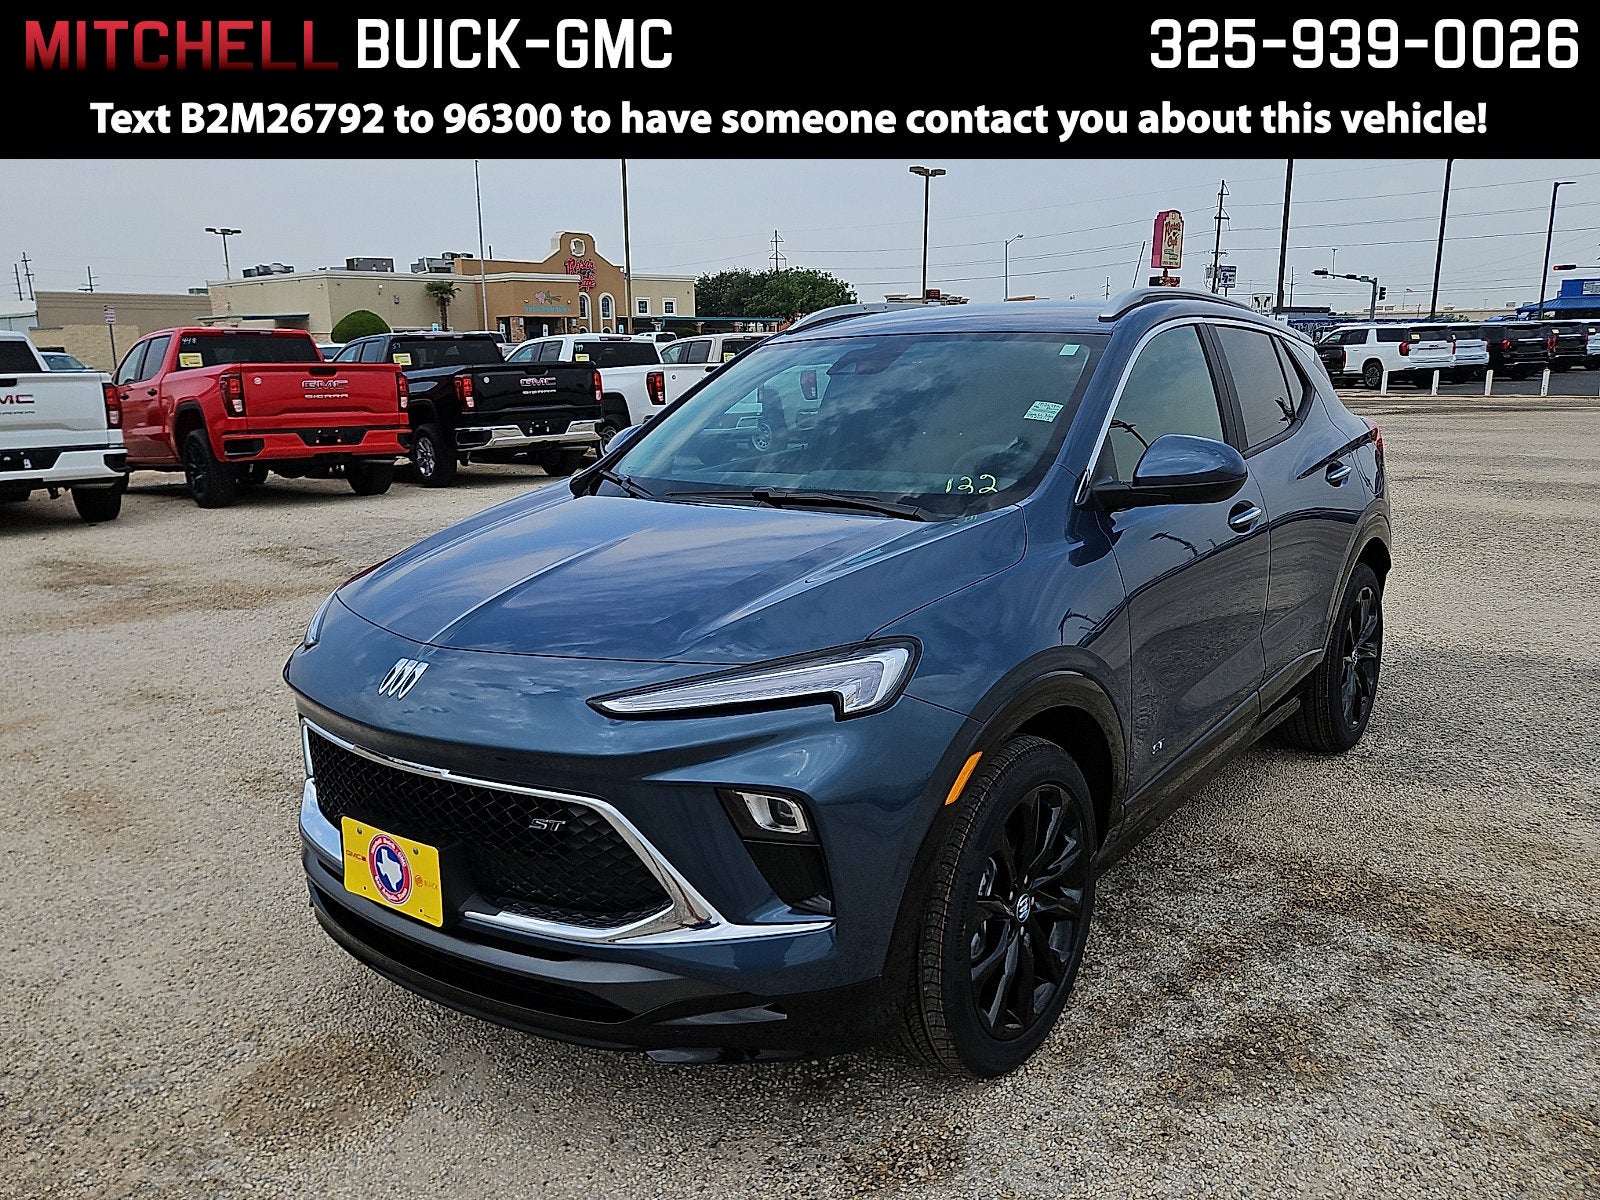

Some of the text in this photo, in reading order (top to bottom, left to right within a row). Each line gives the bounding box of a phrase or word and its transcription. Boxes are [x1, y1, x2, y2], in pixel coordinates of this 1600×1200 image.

[301, 379, 349, 390] GMC
[519, 377, 557, 387] GMC
[0, 394, 35, 405] MC
[528, 818, 566, 831] ST
